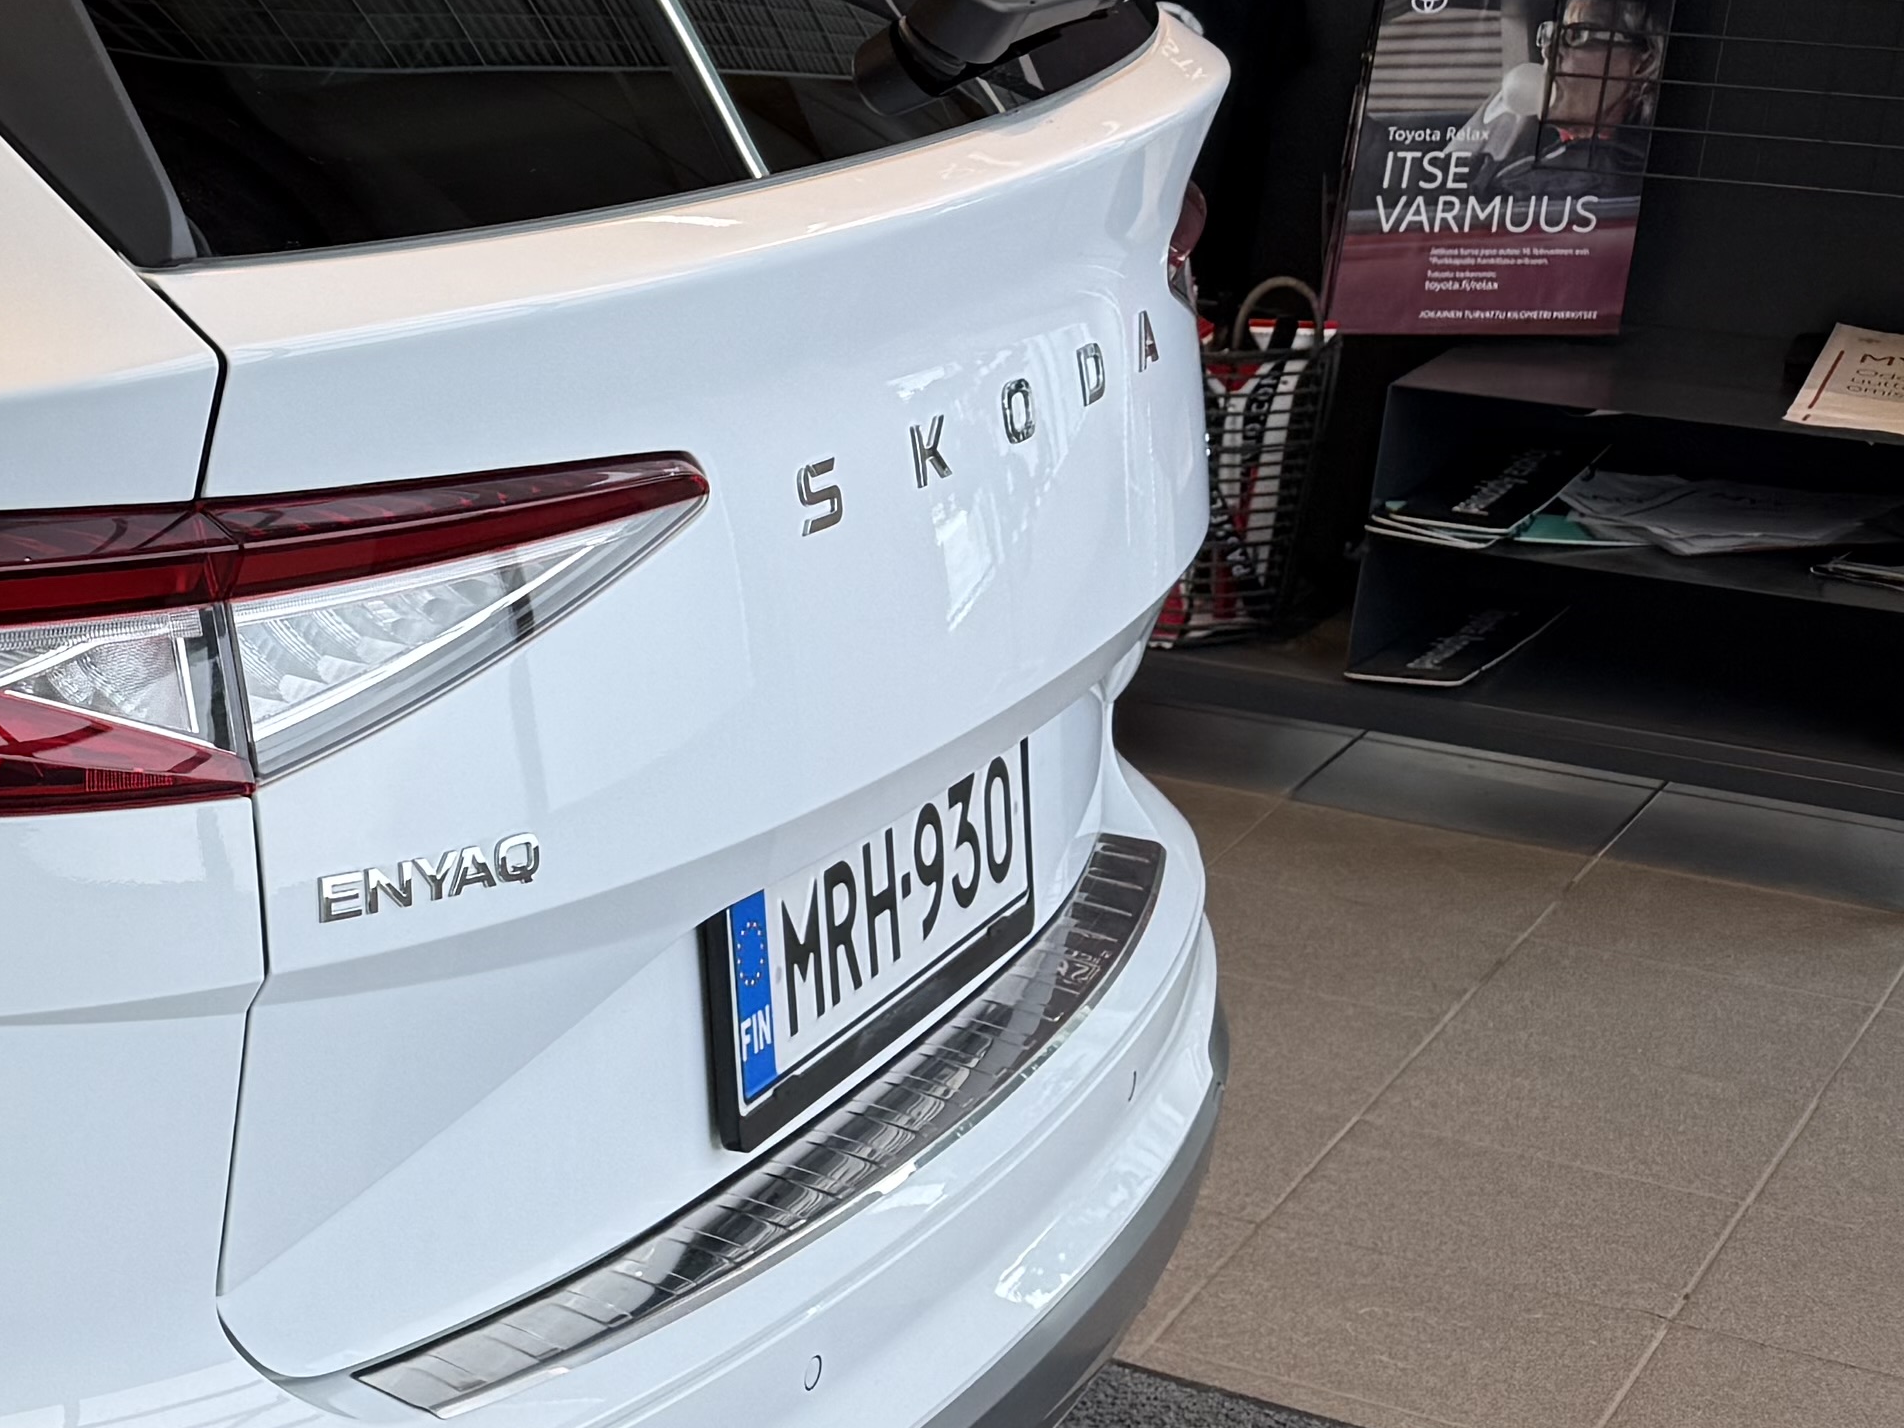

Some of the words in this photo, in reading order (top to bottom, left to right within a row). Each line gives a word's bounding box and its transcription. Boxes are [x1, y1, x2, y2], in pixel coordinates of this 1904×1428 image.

[1388, 126, 1441, 144] Toyota
[1445, 126, 1490, 142] Relax
[1382, 150, 1473, 189] ITSE
[1375, 194, 1599, 233] VARMUUS
[796, 310, 1160, 537] SKODA
[317, 831, 541, 924] ENYAQ
[781, 756, 1014, 1038] MRH-930
[740, 1004, 773, 1062] FIN
